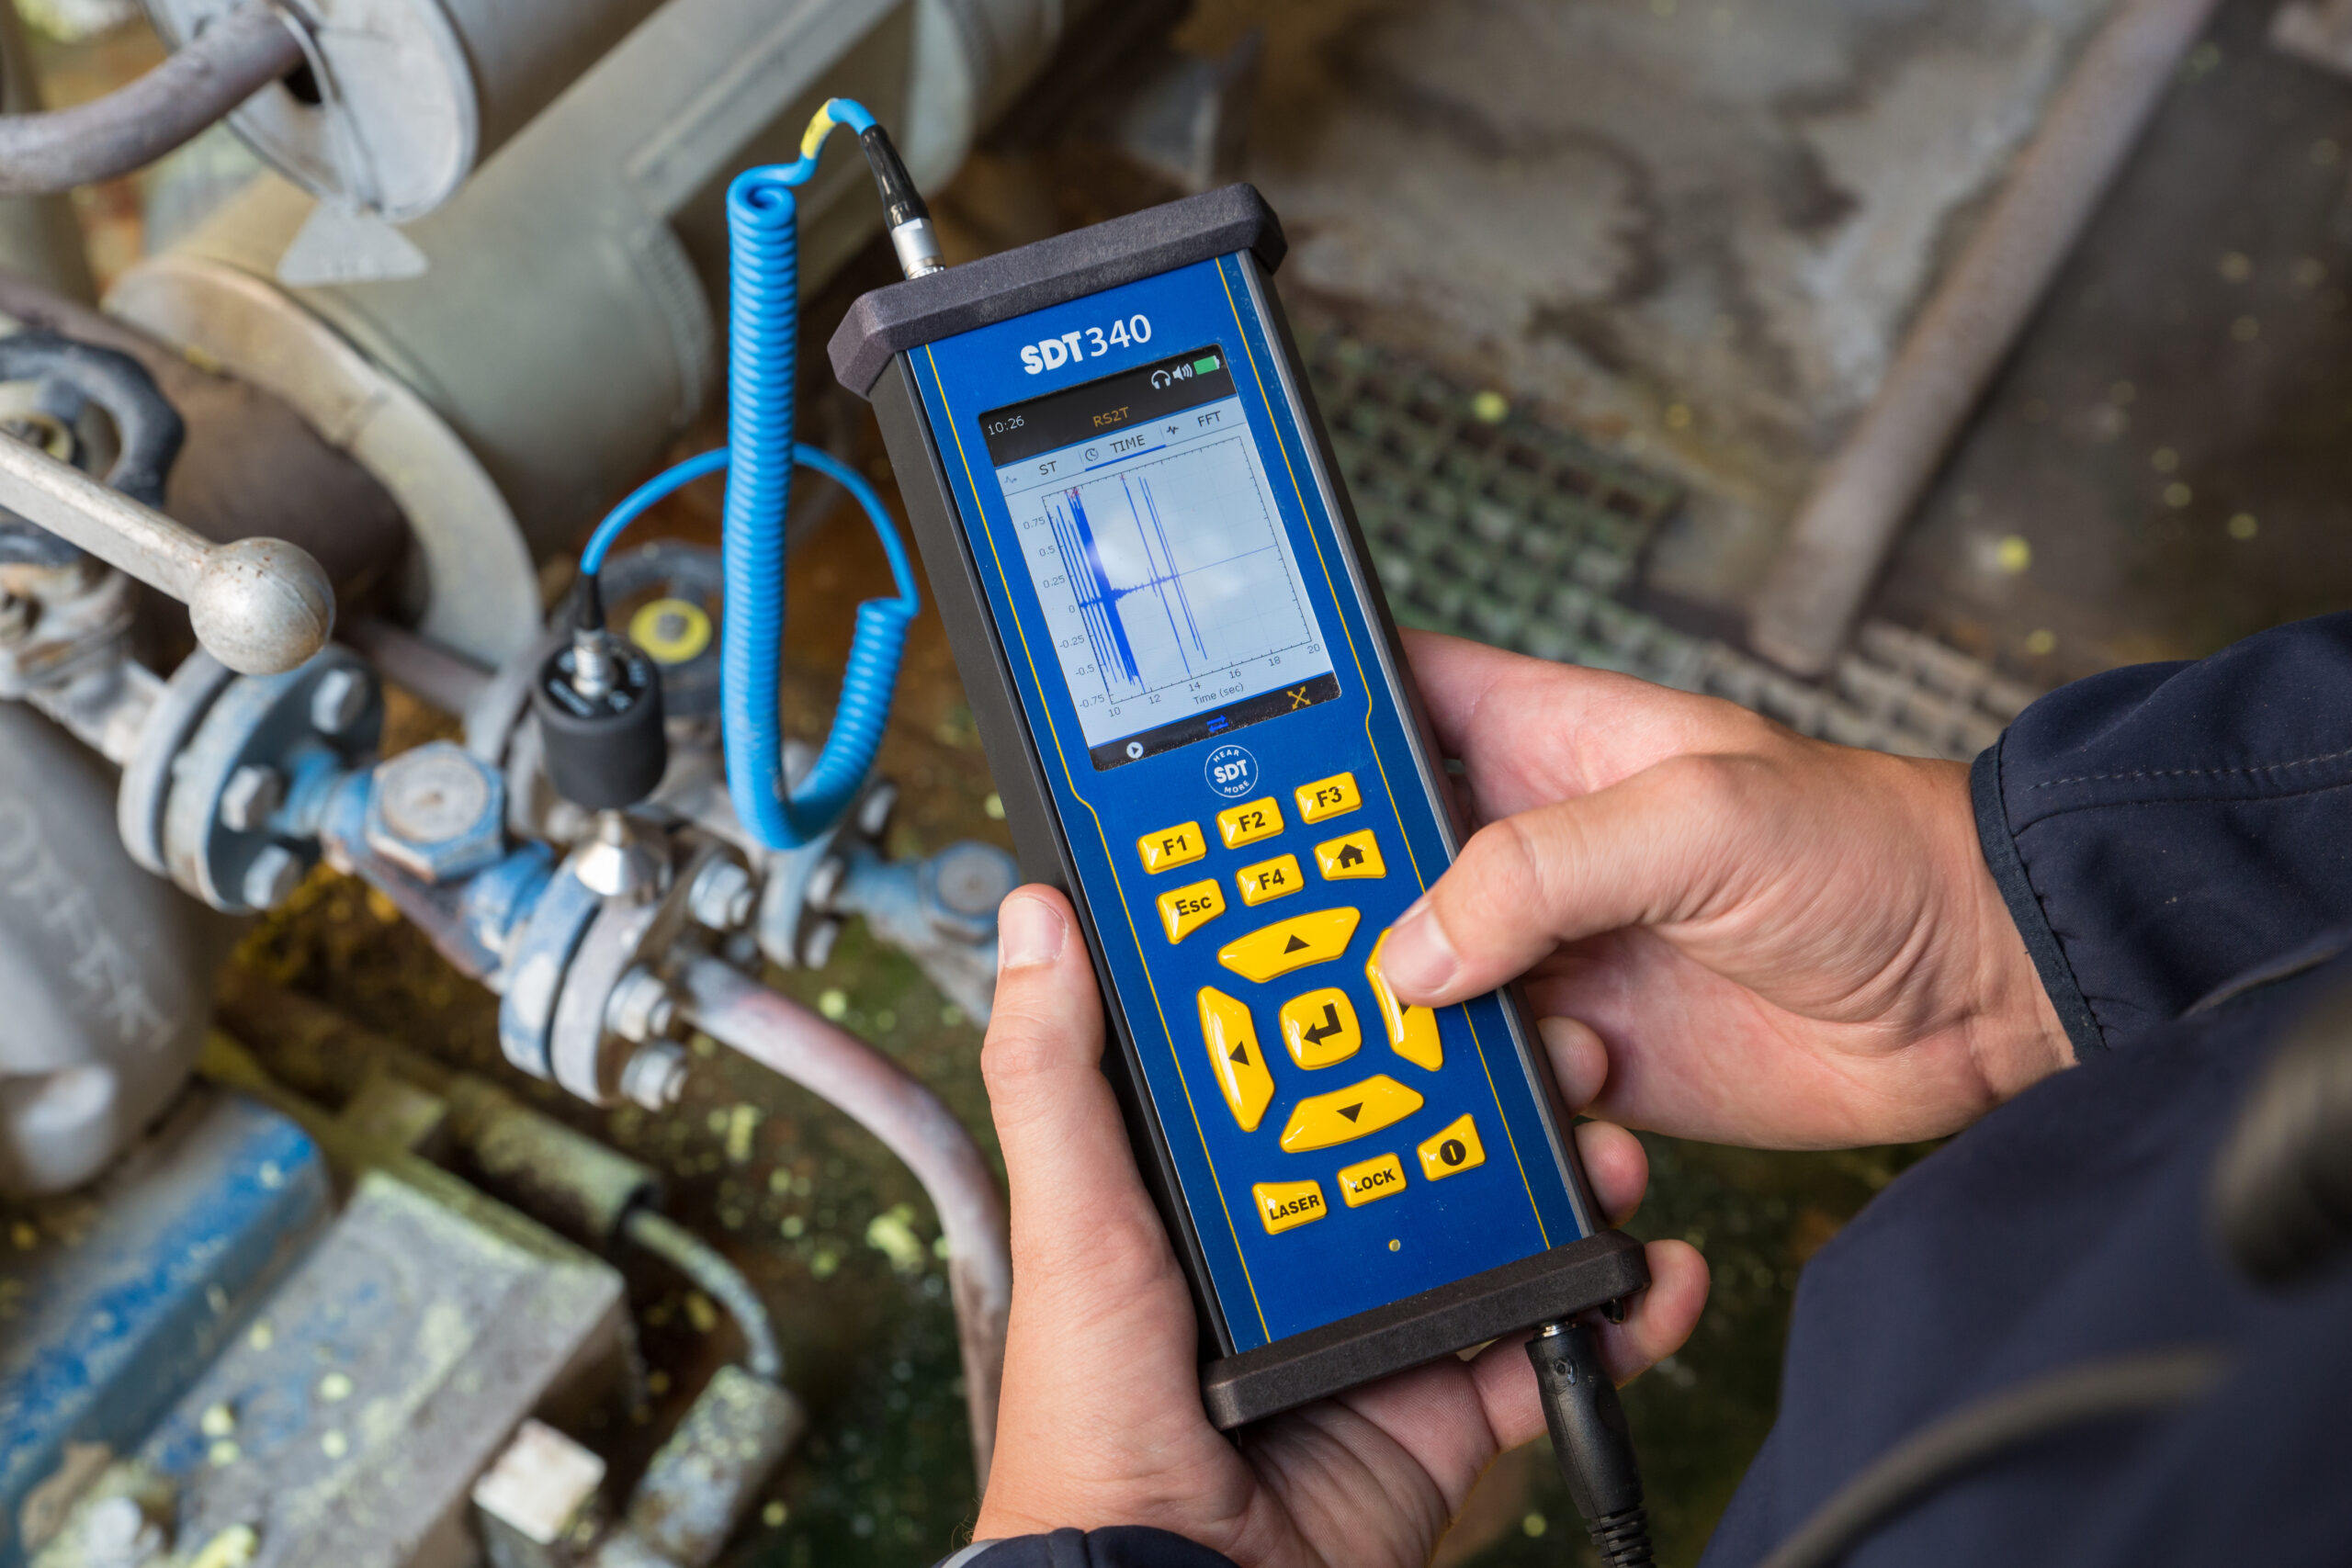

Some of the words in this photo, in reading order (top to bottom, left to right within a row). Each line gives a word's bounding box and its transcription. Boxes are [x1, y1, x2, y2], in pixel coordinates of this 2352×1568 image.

[1020, 314, 1152, 375] SDT340
[1092, 407, 1129, 427] RS2T
[1197, 411, 1220, 427] FFT
[988, 415, 1024, 435] 10:26
[1110, 434, 1146, 454] TIME
[1039, 461, 1057, 476] ST
[1023, 516, 1046, 530] 0.75
[1039, 545, 1056, 558] 0.5
[1043, 575, 1066, 589] 0.25
[1069, 604, 1076, 614] 0
[1059, 635, 1085, 649] -0.25
[1306, 643, 1320, 654] 20
[1268, 656, 1281, 667] 18
[1075, 664, 1095, 676] -0.5
[1229, 669, 1241, 679] 16
[1188, 682, 1201, 692] 14
[1193, 689, 1216, 705] Time
[1219, 682, 1244, 698] (sec)
[1079, 694, 1105, 708] -0.75
[1149, 694, 1161, 705] 12
[1108, 706, 1121, 717] 10
[1213, 749, 1239, 762] HEAR
[1214, 760, 1249, 784] SDT
[1224, 781, 1250, 794] MORE
[1316, 785, 1342, 807] F3
[1238, 810, 1266, 832] F2
[1162, 835, 1187, 856] F1
[1258, 868, 1285, 891] F4
[1175, 896, 1213, 917] Esc
[1353, 1168, 1396, 1193] LOCK
[1269, 1194, 1320, 1221] LASER
